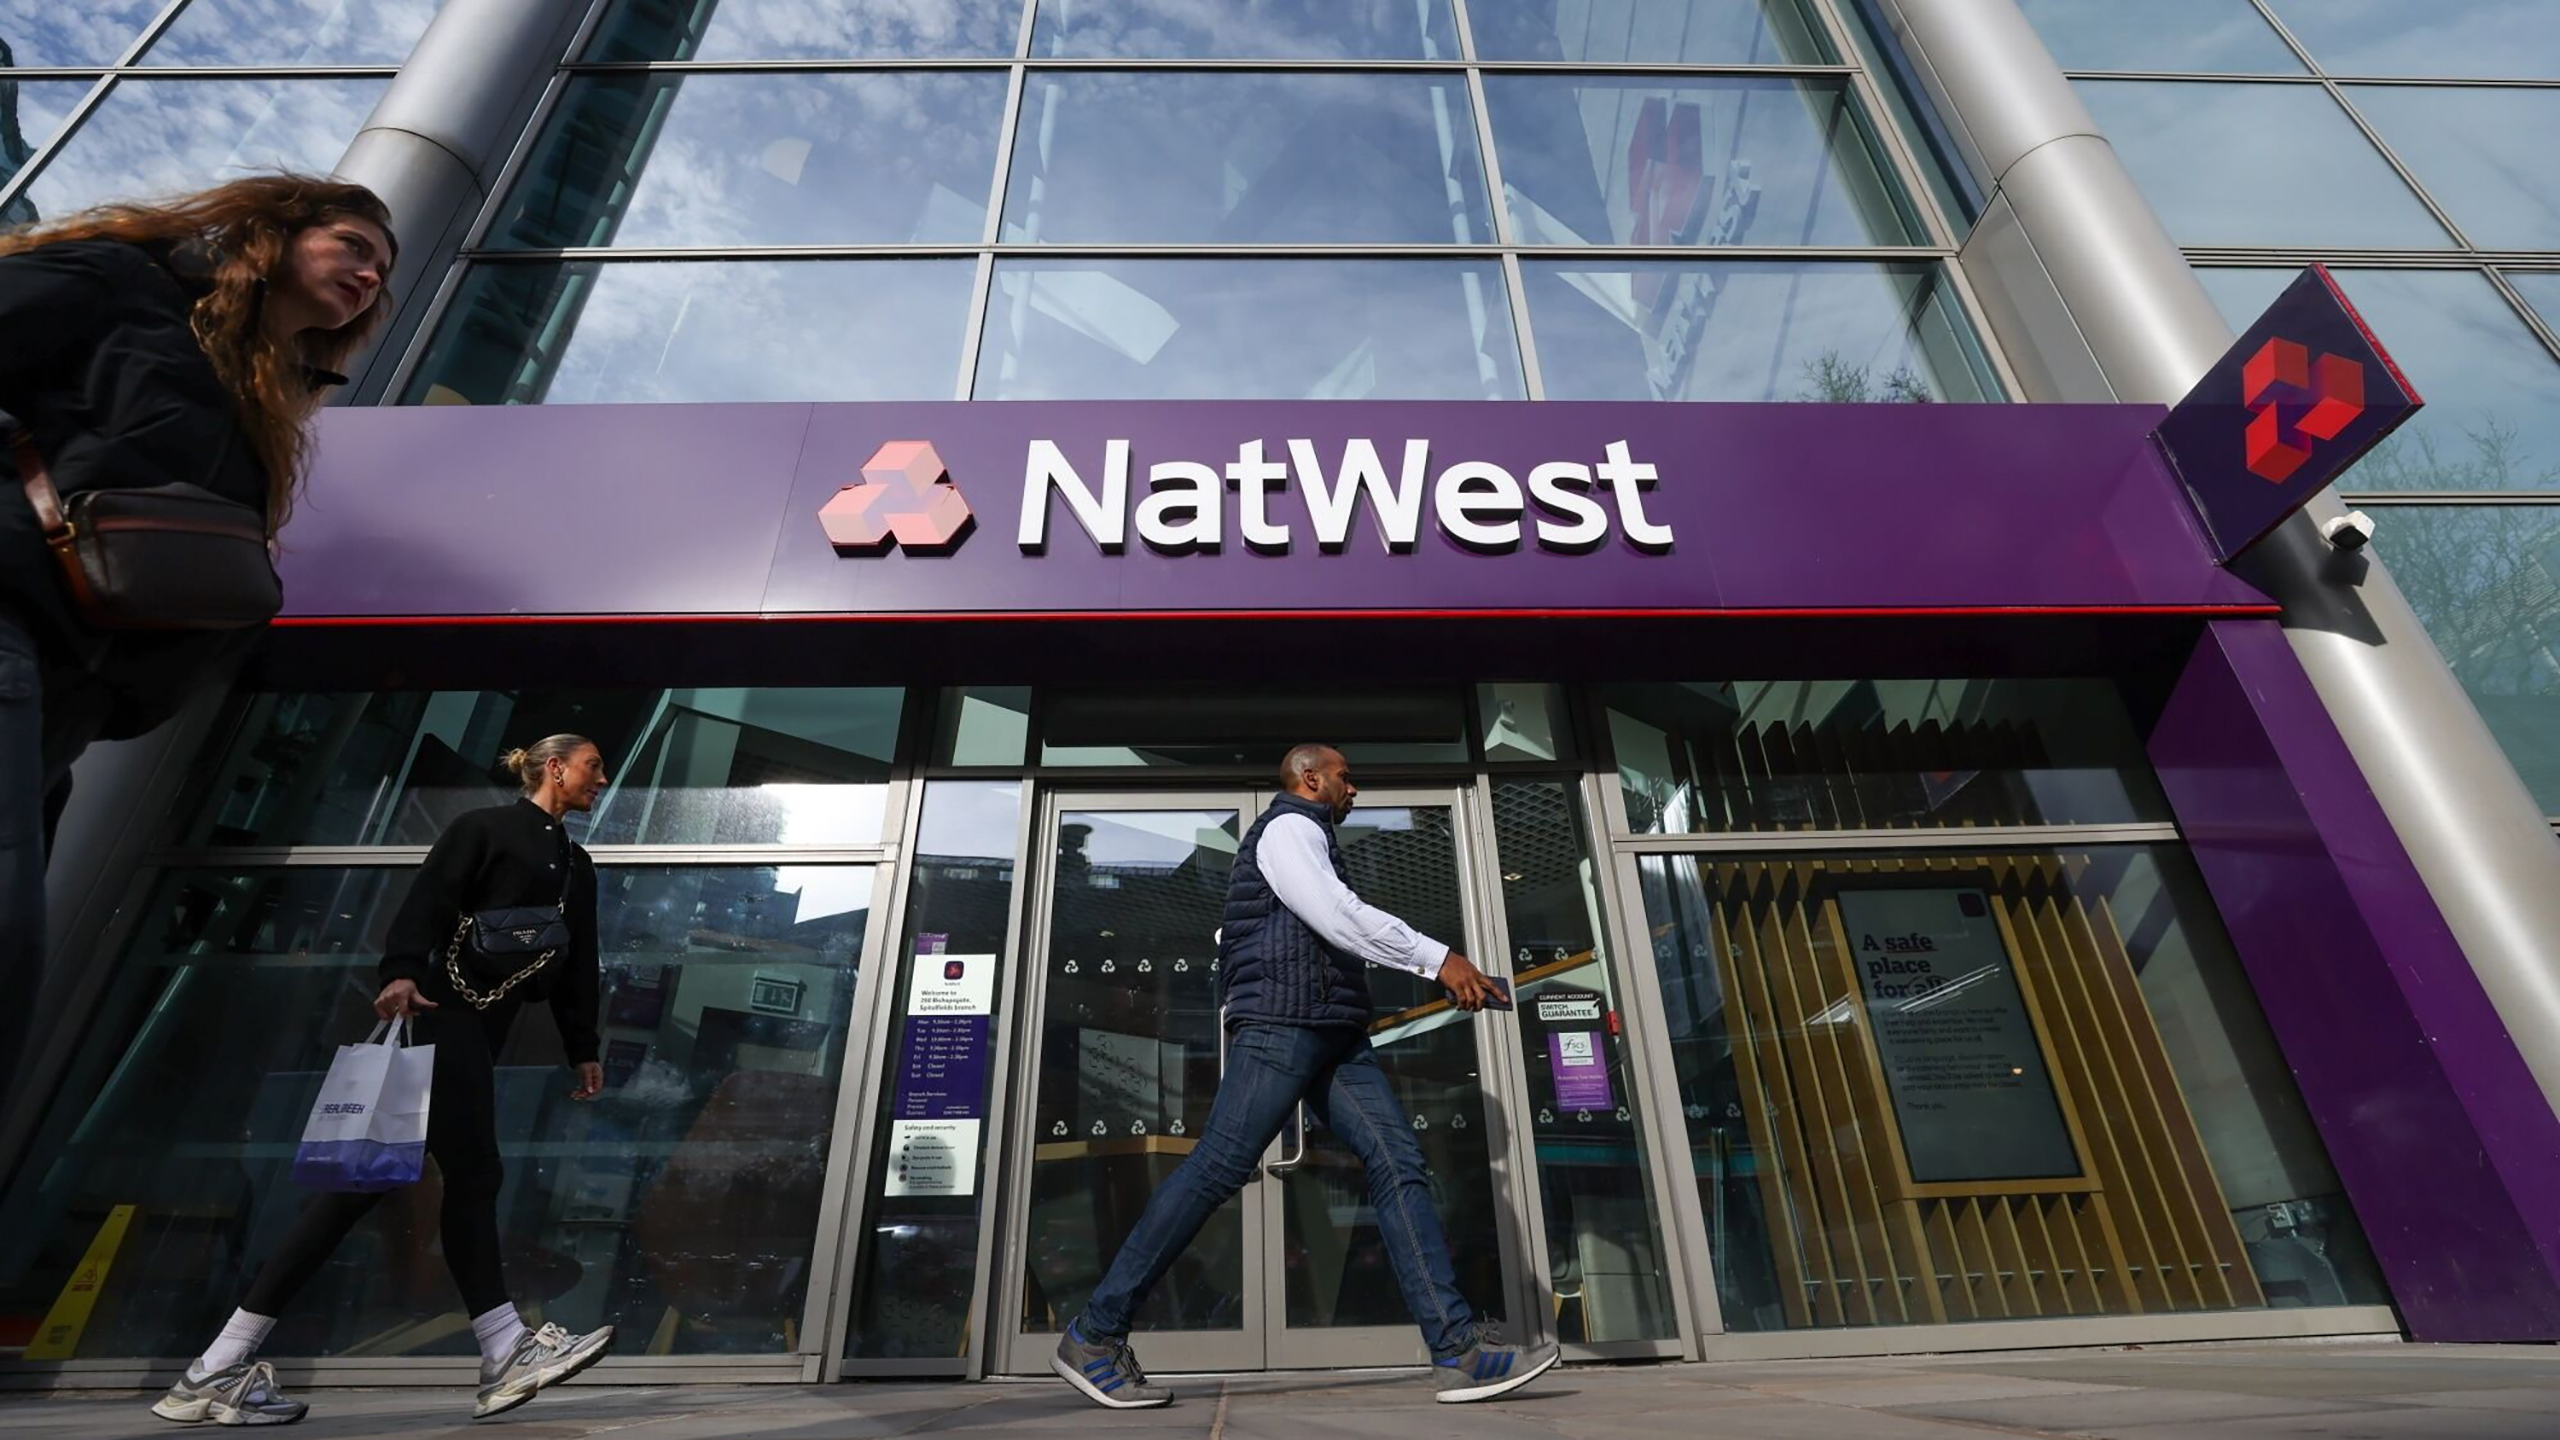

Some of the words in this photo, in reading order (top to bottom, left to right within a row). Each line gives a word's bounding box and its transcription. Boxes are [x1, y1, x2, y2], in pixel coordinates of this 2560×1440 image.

[1017, 438, 1675, 556] NatWest
[1862, 934, 1881, 951] A
[1885, 932, 1933, 950] safe
[1867, 957, 1932, 979] place
[1873, 981, 1908, 999] for
[1541, 1009, 1593, 1018] GUARANTEE
